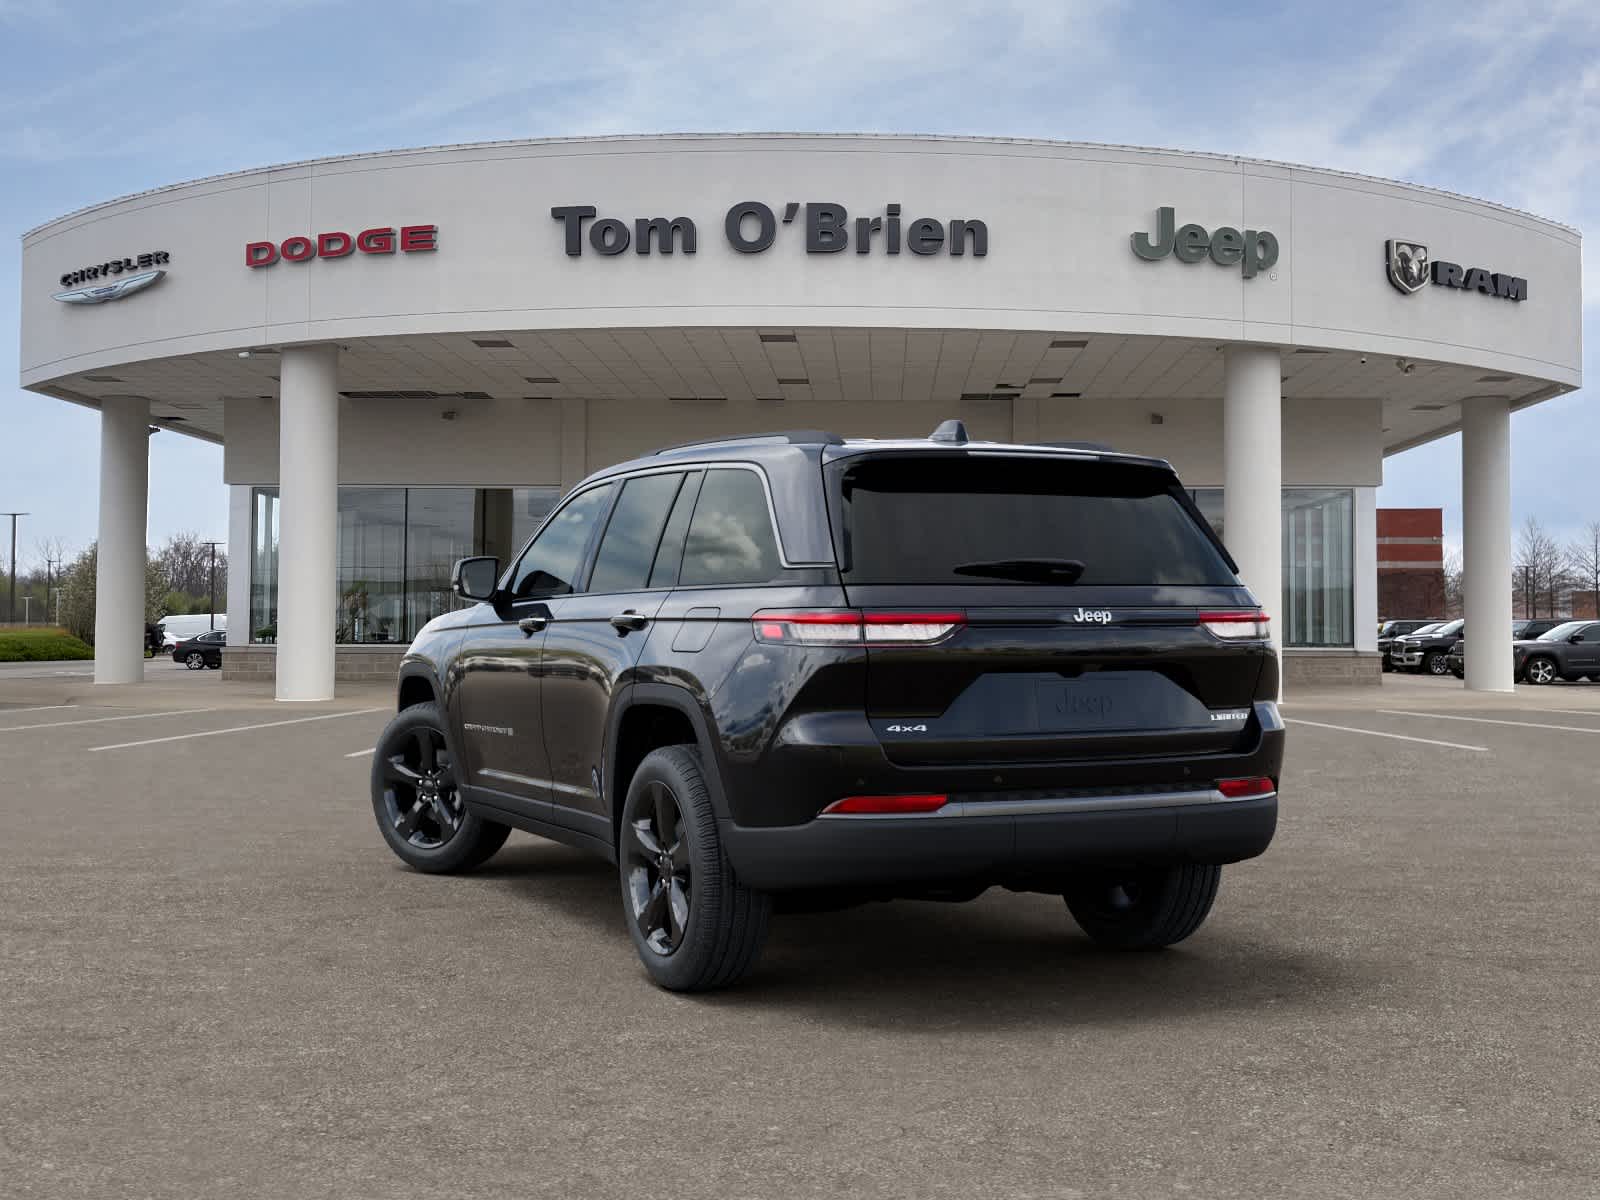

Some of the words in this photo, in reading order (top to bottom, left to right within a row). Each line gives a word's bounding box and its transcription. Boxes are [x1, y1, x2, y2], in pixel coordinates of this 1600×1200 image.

[245, 225, 438, 269] DODGE
[551, 205, 697, 256] Tom
[725, 201, 989, 257] O'Brien
[1130, 206, 1279, 279] Jeep
[60, 250, 170, 287] CHRYSLER
[1431, 260, 1528, 302] RAM
[1073, 607, 1112, 625] Jeep
